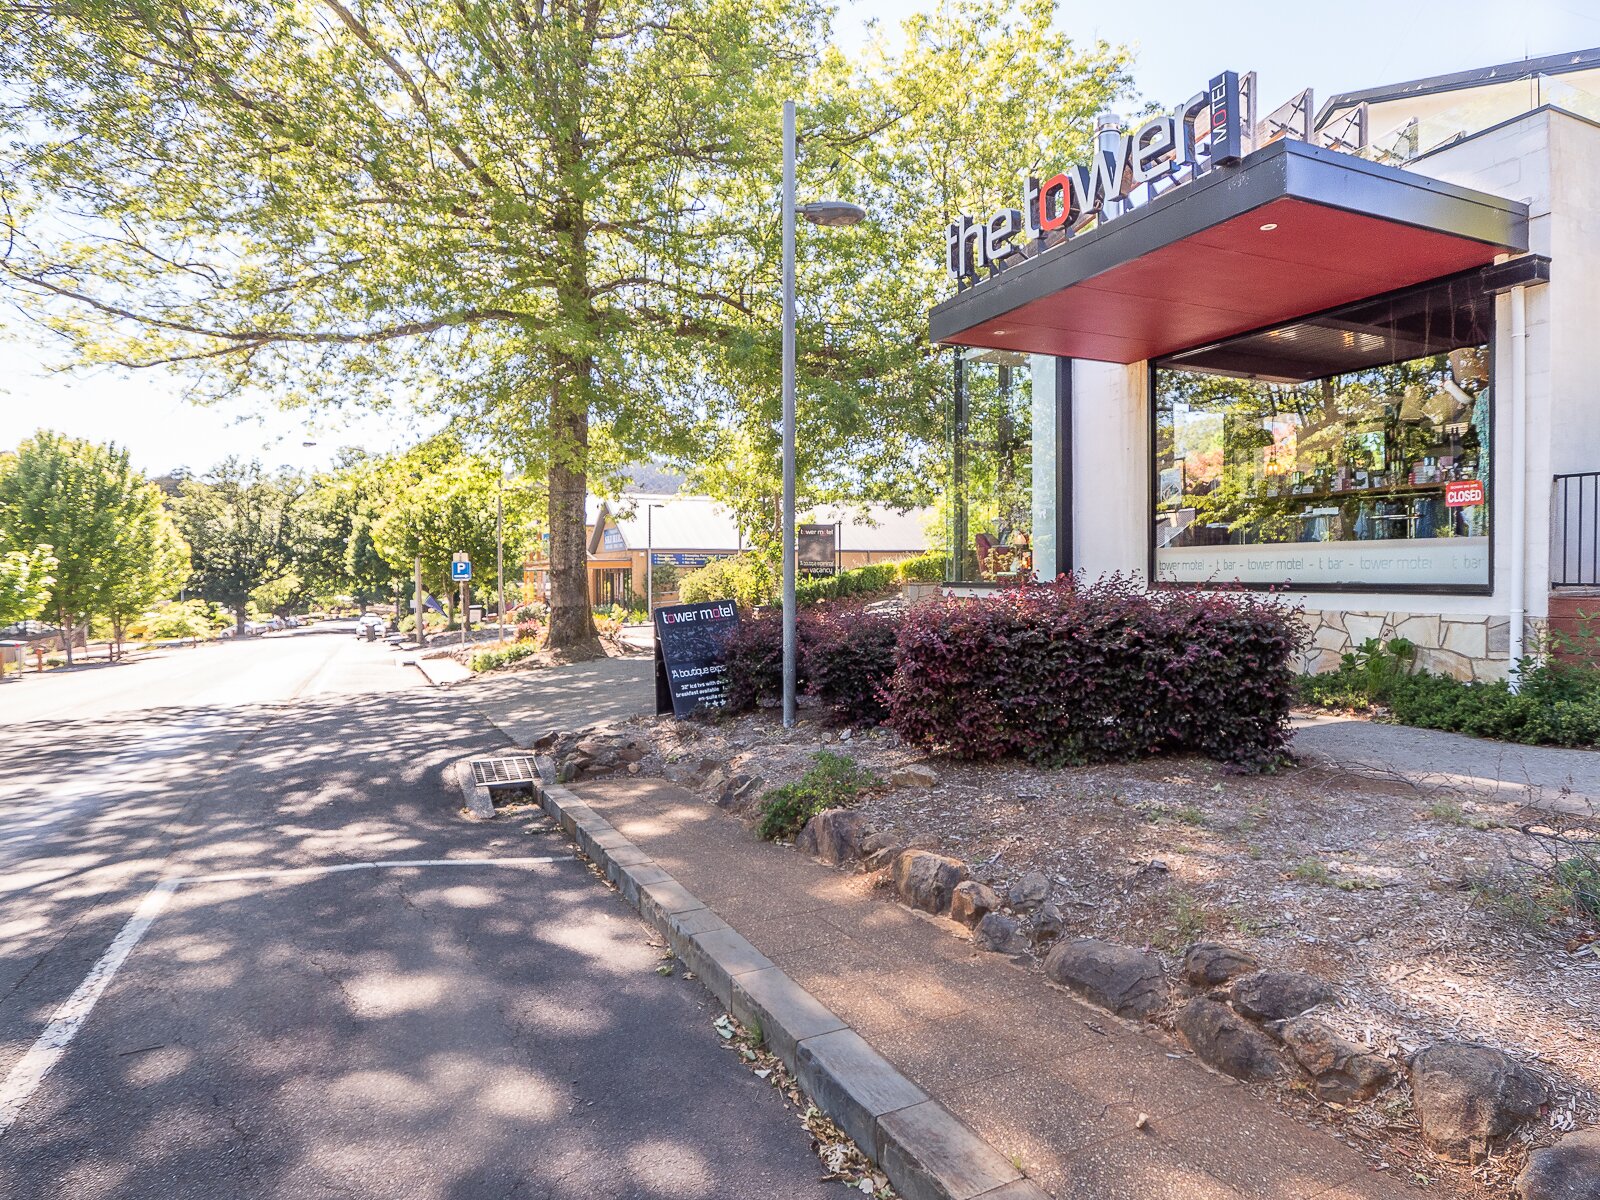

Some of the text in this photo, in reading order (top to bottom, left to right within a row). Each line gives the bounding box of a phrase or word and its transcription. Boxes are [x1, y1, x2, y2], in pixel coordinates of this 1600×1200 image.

[1211, 74, 1227, 145] MOTEL
[946, 91, 1212, 279] the tower
[1447, 489, 1482, 503] CLOSED
[457, 563, 466, 573] P
[1159, 559, 1182, 571] tower
[1182, 559, 1205, 570] motel
[1223, 559, 1236, 570] bar
[1247, 559, 1274, 570] tower
[1276, 557, 1304, 570] motel
[1327, 557, 1343, 570] bar
[1360, 556, 1392, 570] tower
[662, 603, 734, 624] tower motel
